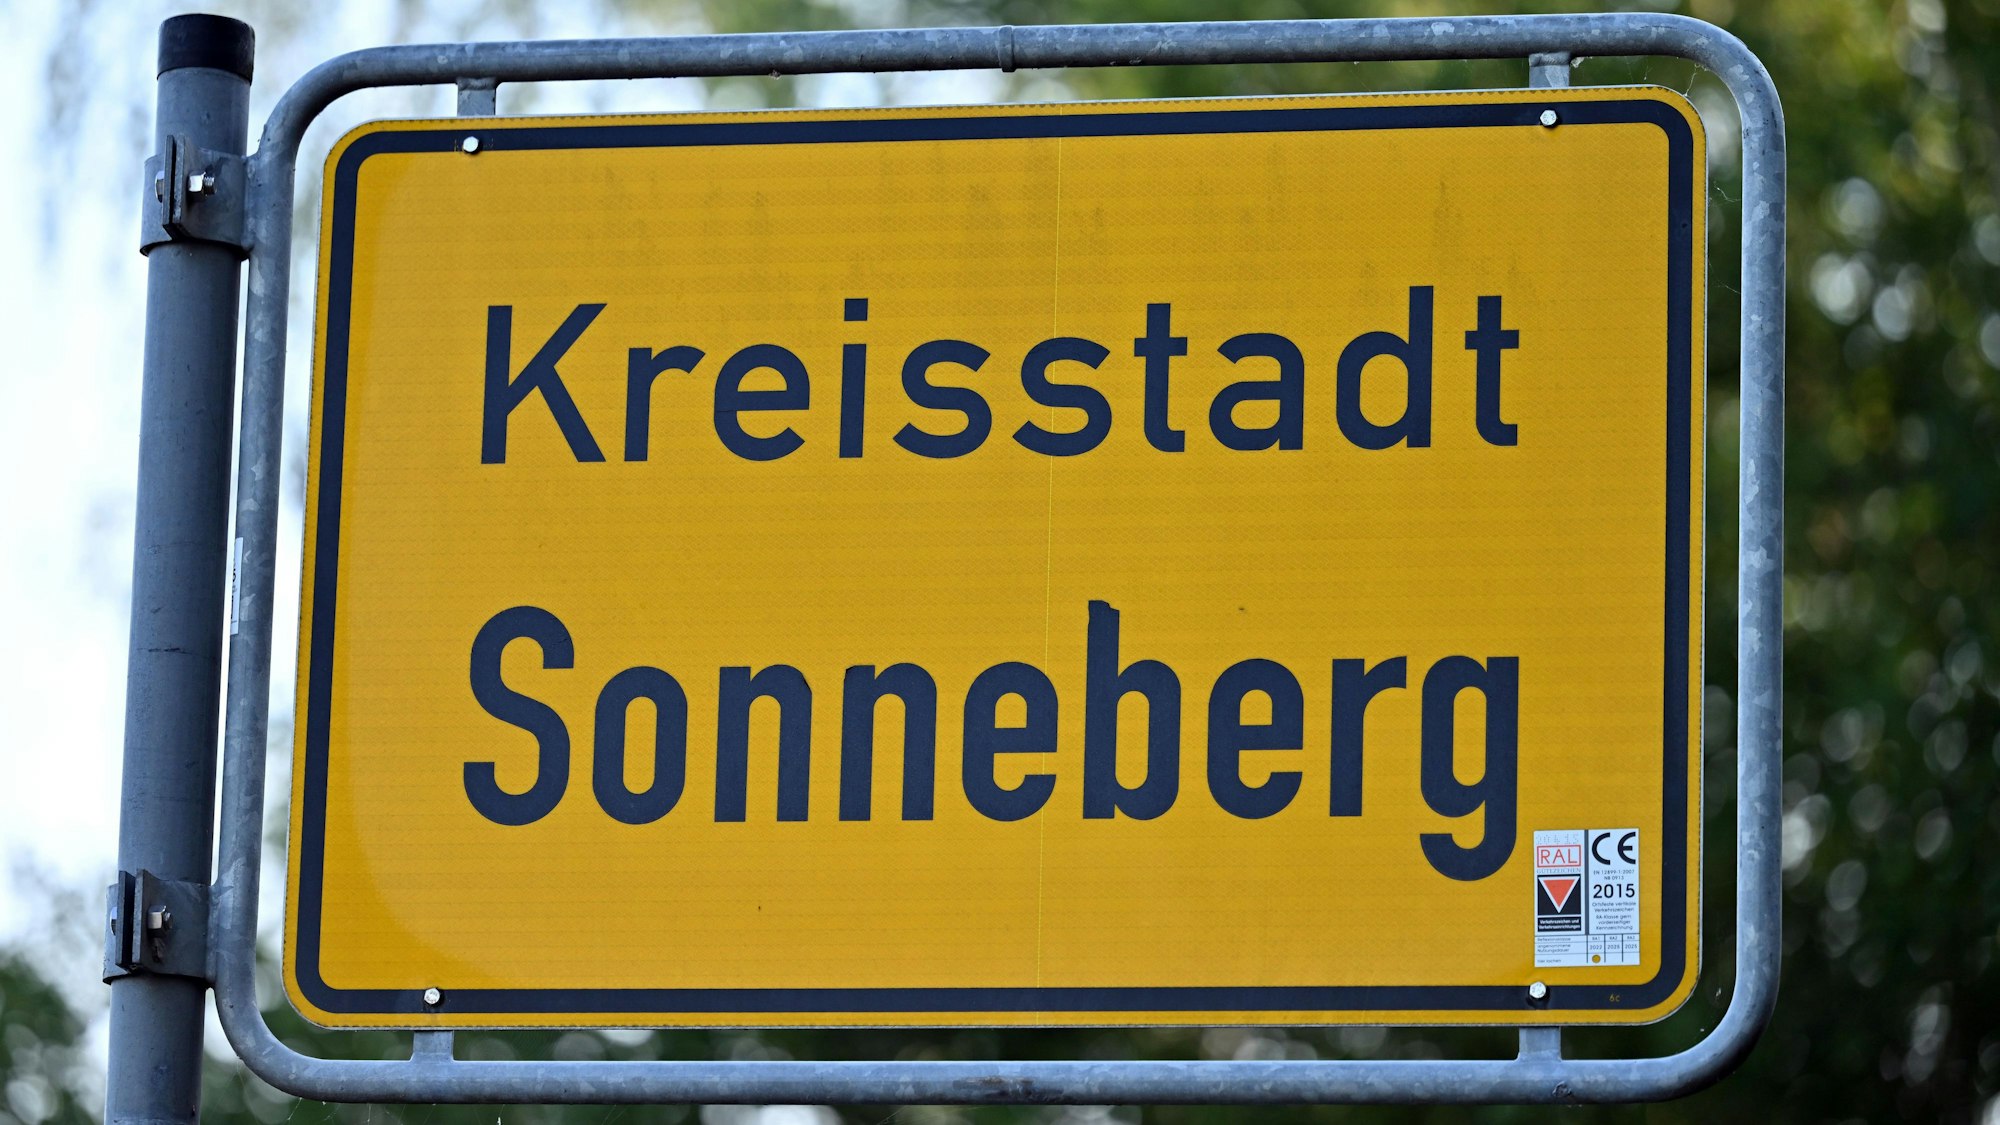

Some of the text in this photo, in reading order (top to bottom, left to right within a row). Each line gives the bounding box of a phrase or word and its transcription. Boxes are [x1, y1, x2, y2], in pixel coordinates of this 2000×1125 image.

[481, 286, 1520, 464] Kreisstadt
[464, 600, 1520, 882] Sonneberg
[1540, 848, 1578, 864] RAL
[1591, 831, 1636, 865] CE
[1593, 883, 1635, 899] 2015
